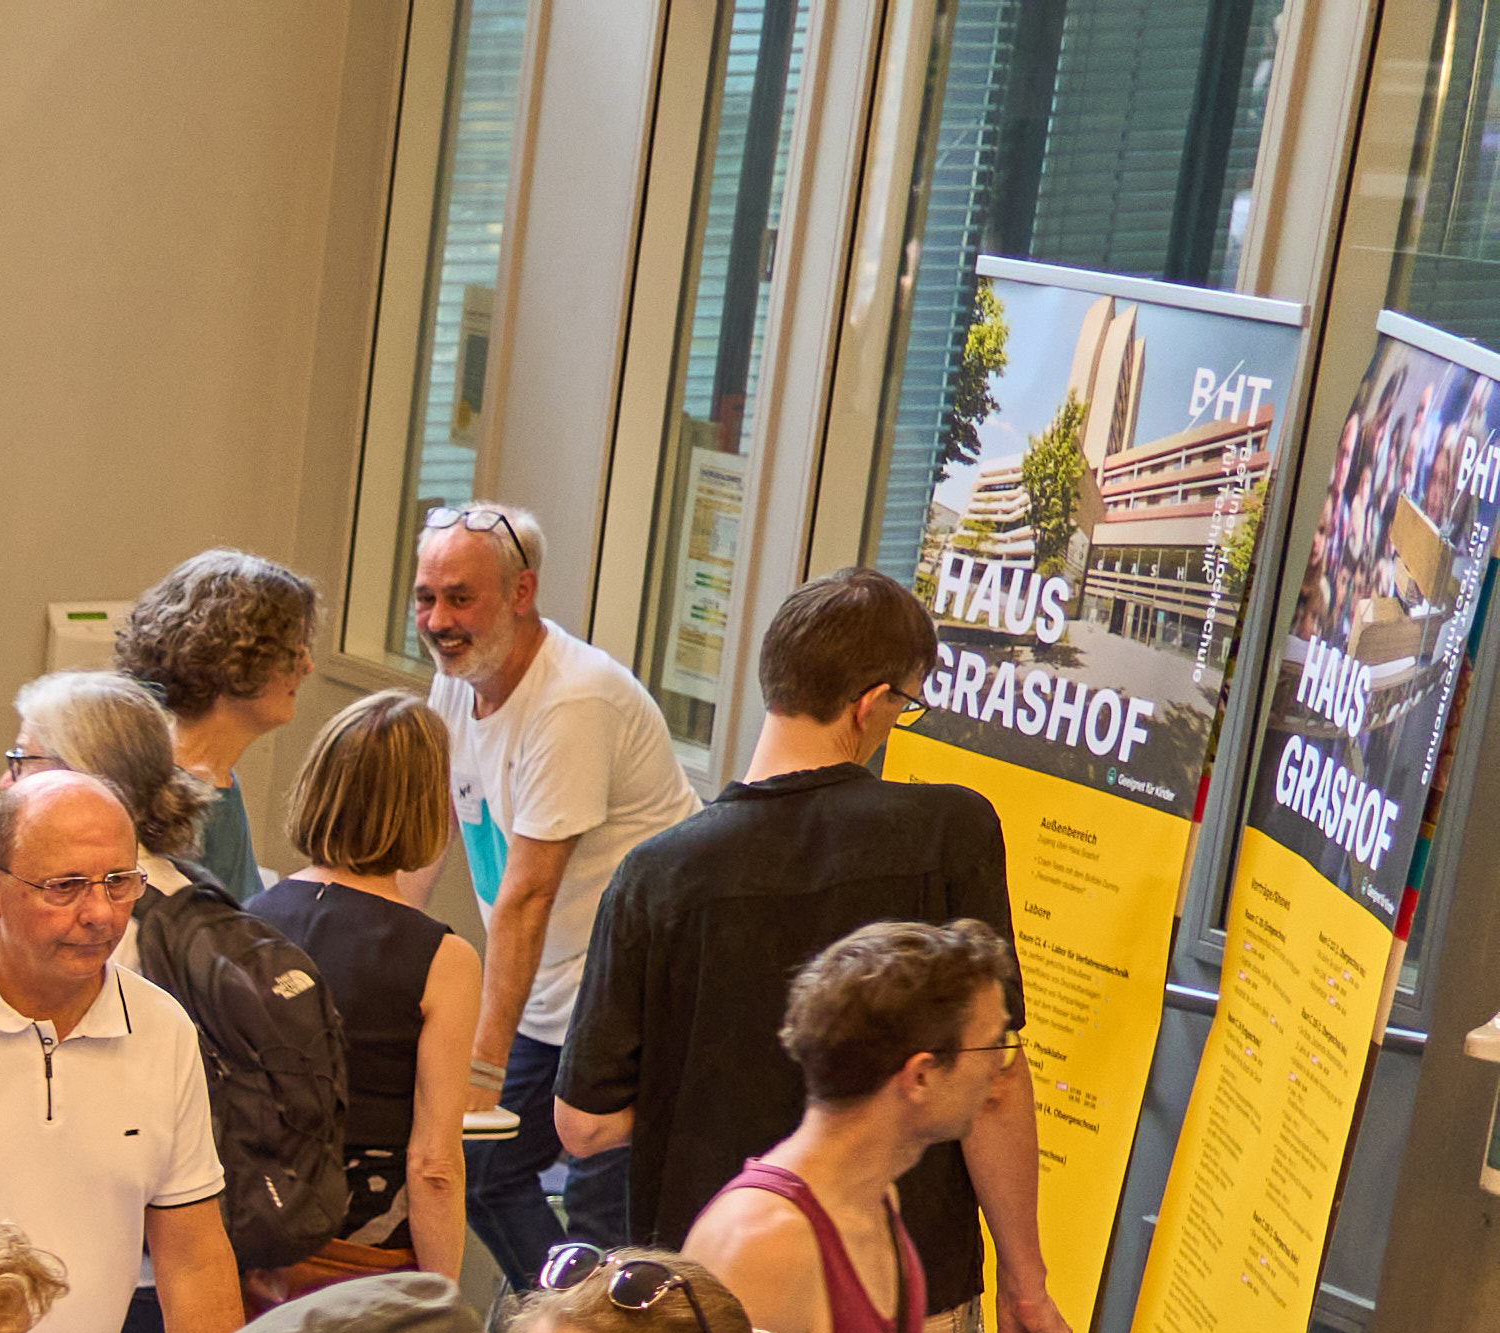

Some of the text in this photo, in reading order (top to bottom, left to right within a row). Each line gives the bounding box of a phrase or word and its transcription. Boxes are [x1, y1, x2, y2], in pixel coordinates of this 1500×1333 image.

[1188, 366, 1273, 428] BHT
[934, 550, 1069, 644] HAUS
[1192, 447, 1252, 683] Berliner Hochschule
[923, 641, 1155, 763] GRASHOF
[1296, 634, 1371, 738] HAUS
[1275, 734, 1399, 872] GRASHOF
